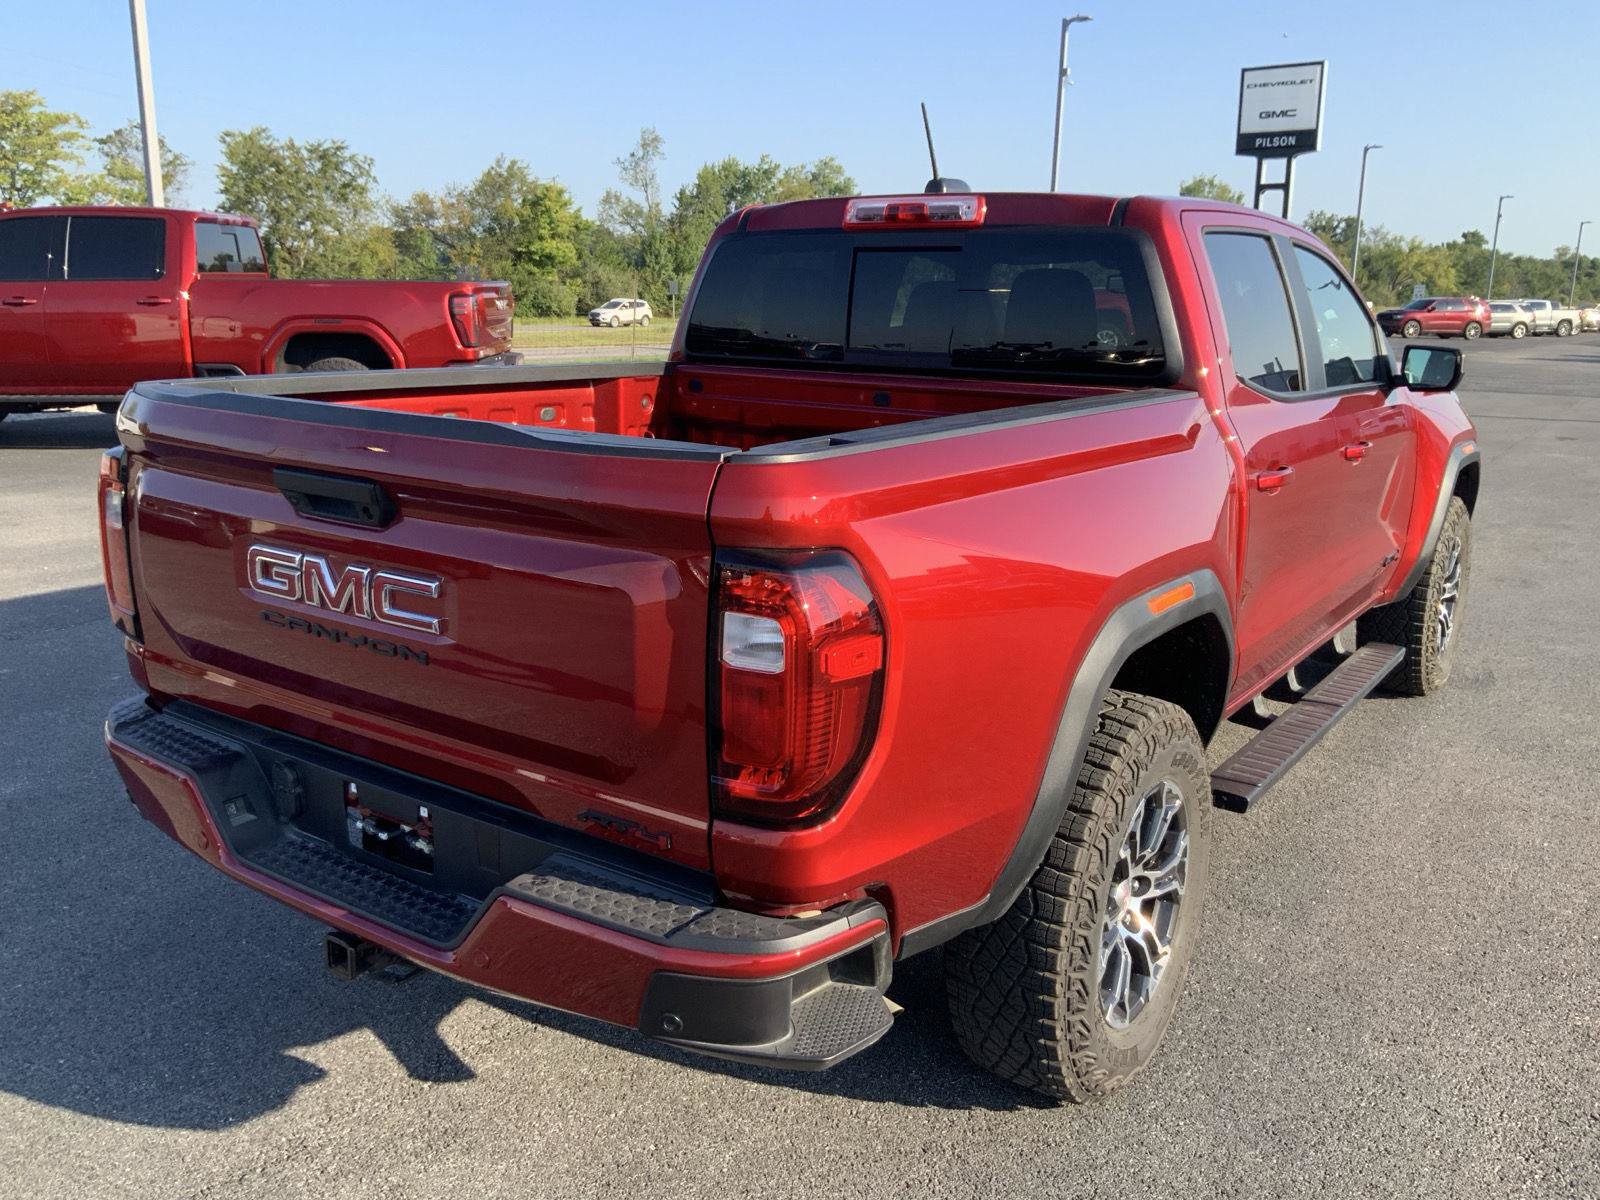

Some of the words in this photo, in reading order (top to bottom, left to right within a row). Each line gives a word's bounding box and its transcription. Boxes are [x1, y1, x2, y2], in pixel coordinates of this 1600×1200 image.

[1246, 79, 1315, 89] CHEVROLET
[1259, 109, 1297, 120] GMC
[1255, 136, 1296, 148] PILSON
[247, 543, 444, 635] GMC
[258, 610, 431, 666] CANYON
